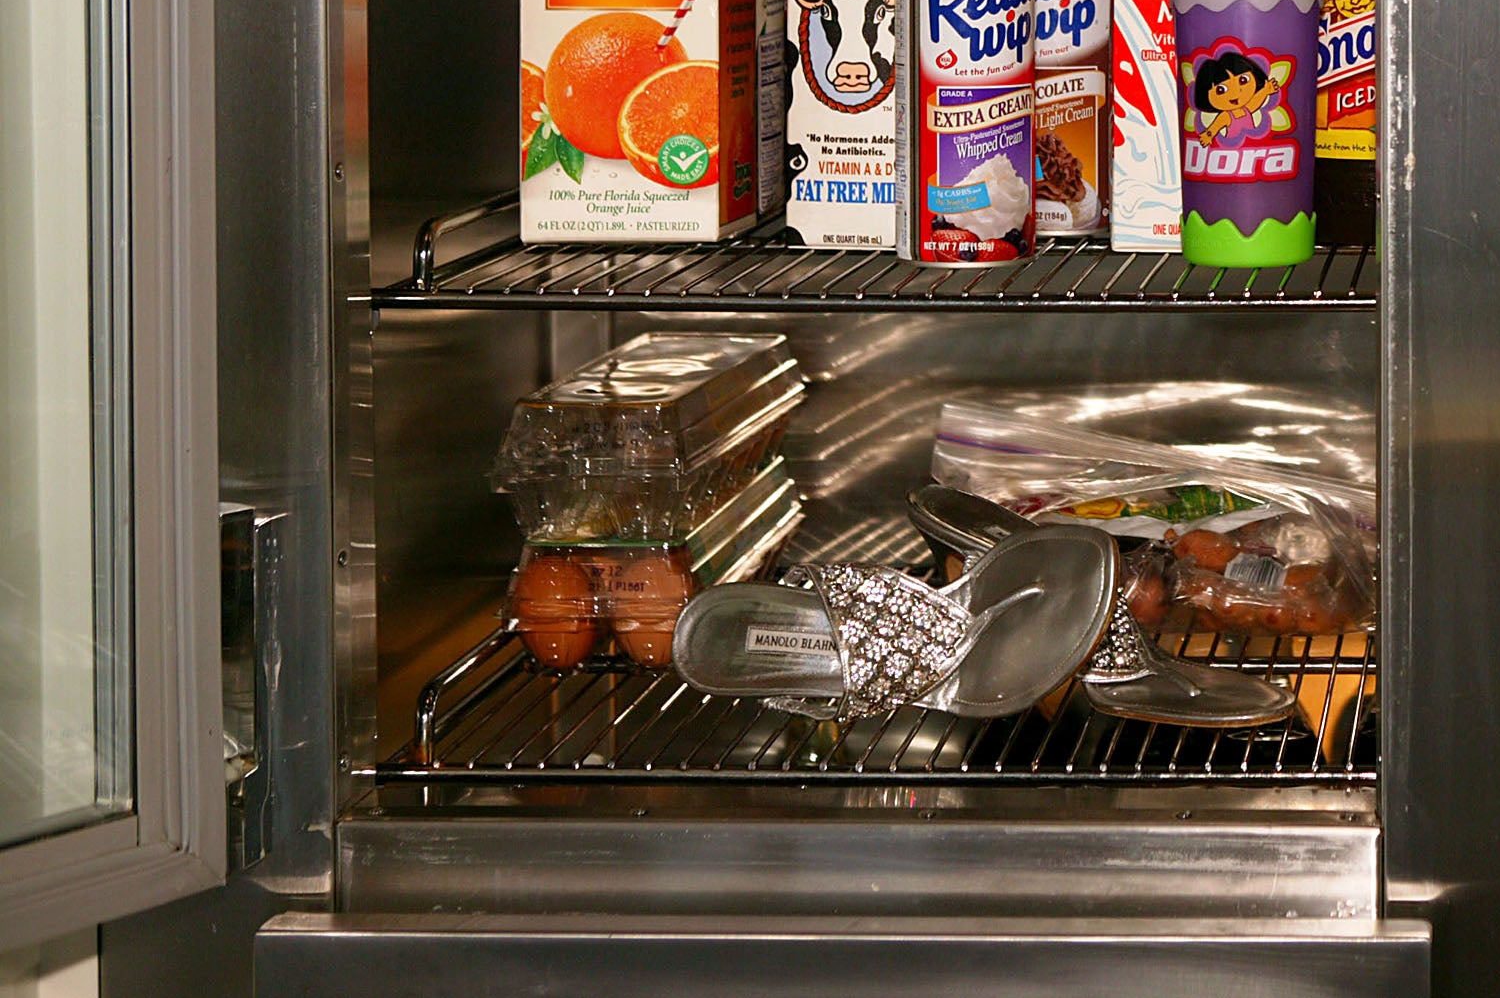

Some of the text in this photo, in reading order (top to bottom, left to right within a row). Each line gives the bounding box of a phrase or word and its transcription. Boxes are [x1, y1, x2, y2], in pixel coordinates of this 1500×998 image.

[970, 10, 1031, 63] wip
[1039, 46, 1069, 57] fun out
[1142, 50, 1167, 60] Ultra
[954, 63, 1015, 77] Let the fun out
[941, 90, 973, 98] GRADE A
[1034, 77, 1085, 102] COLATE
[1336, 87, 1376, 112] ICED
[934, 108, 985, 128] EXTRA
[988, 93, 1033, 118] CREAMY
[1039, 109, 1064, 130] Light
[1065, 105, 1094, 123] Cream
[824, 134, 869, 144] Hormones
[956, 130, 1024, 160] Whipped Cream
[821, 146, 886, 156] No Antibiotics.
[1333, 142, 1366, 152] from the
[661, 137, 700, 172] SMART CHOICES
[1185, 139, 1295, 176] Dora
[670, 160, 705, 181] MADE EASY
[818, 161, 893, 176] VITAMIN A & D
[549, 189, 690, 205] 100% Pure Florida Squeezed
[796, 179, 824, 202] FAT
[827, 181, 868, 204] FREE
[586, 203, 652, 216] Orange Juice
[538, 221, 549, 231] 64
[550, 221, 562, 231] FL
[562, 221, 577, 231] OZ
[636, 221, 700, 232] PASTEURIZED
[1153, 224, 1167, 235] ONE
[823, 234, 836, 244] ONE
[836, 235, 856, 244] QUART
[923, 241, 995, 252] NET WT 7 OZ (198g)
[755, 635, 798, 648] MANOLO
